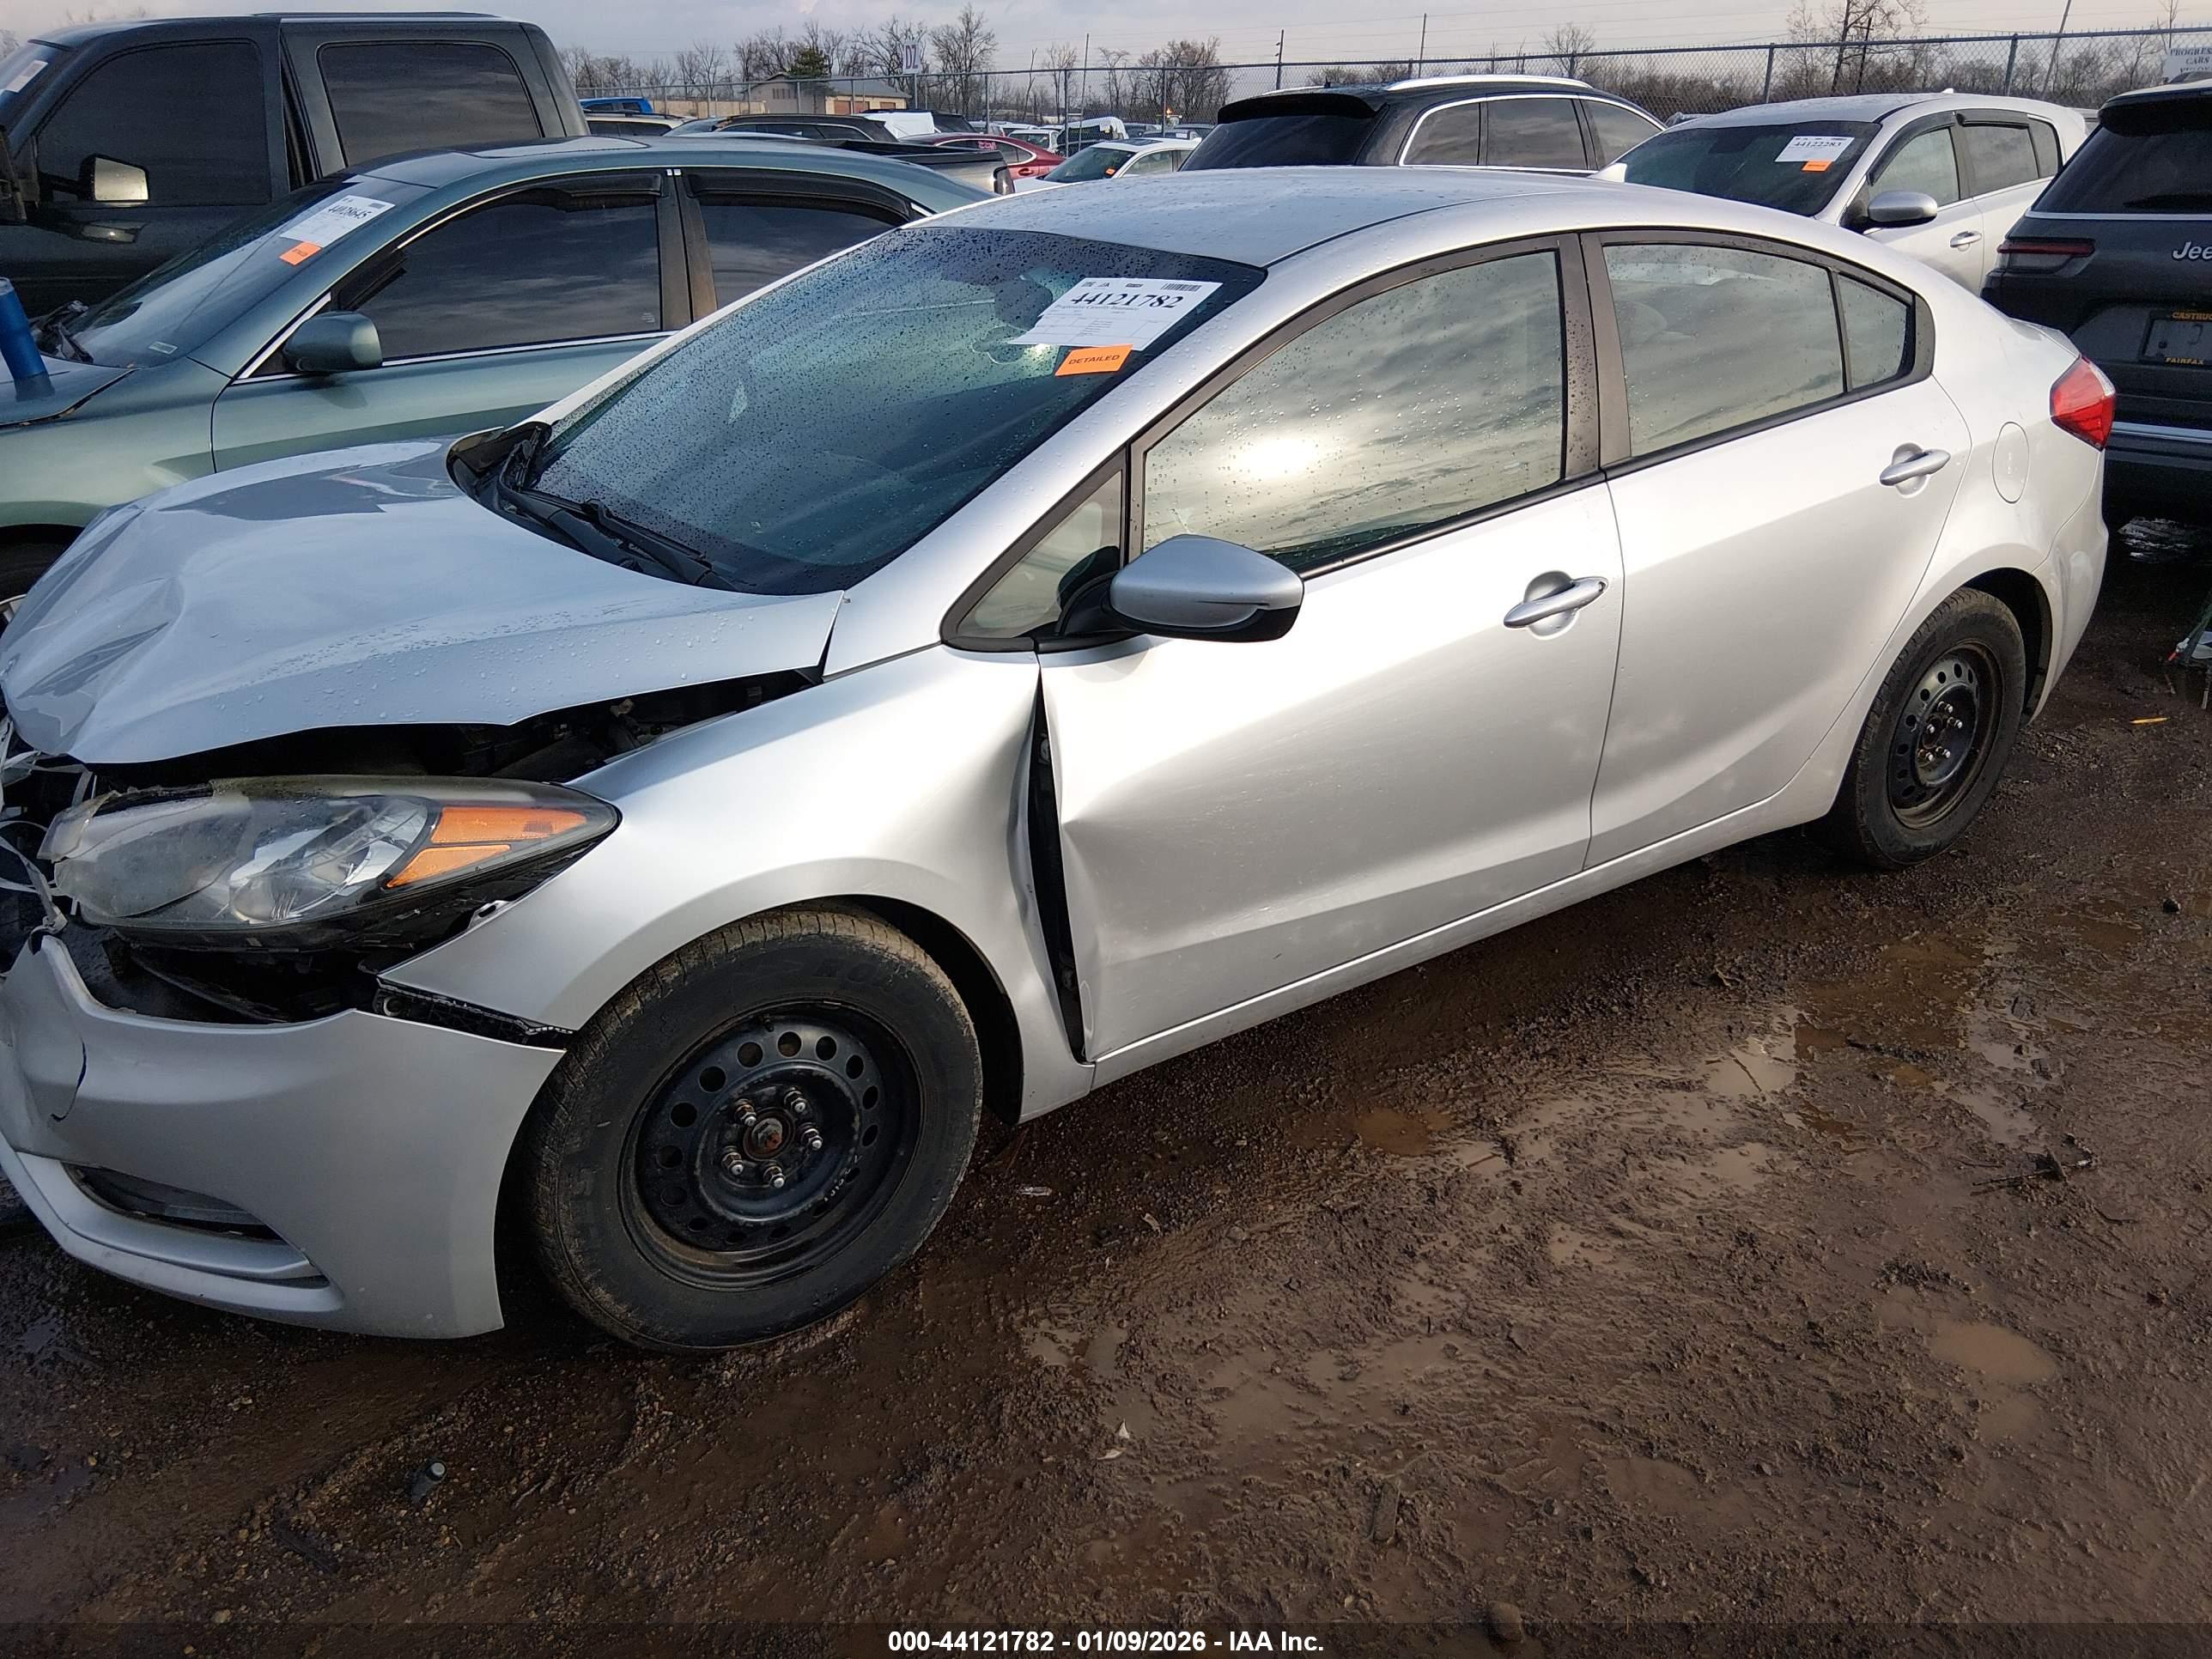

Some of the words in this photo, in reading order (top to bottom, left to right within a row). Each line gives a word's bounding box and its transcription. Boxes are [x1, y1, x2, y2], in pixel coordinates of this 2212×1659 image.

[1071, 292, 1184, 308] 44121782
[1067, 354, 1121, 365] DETAILED
[2166, 356, 2204, 365] FAIRFAX
